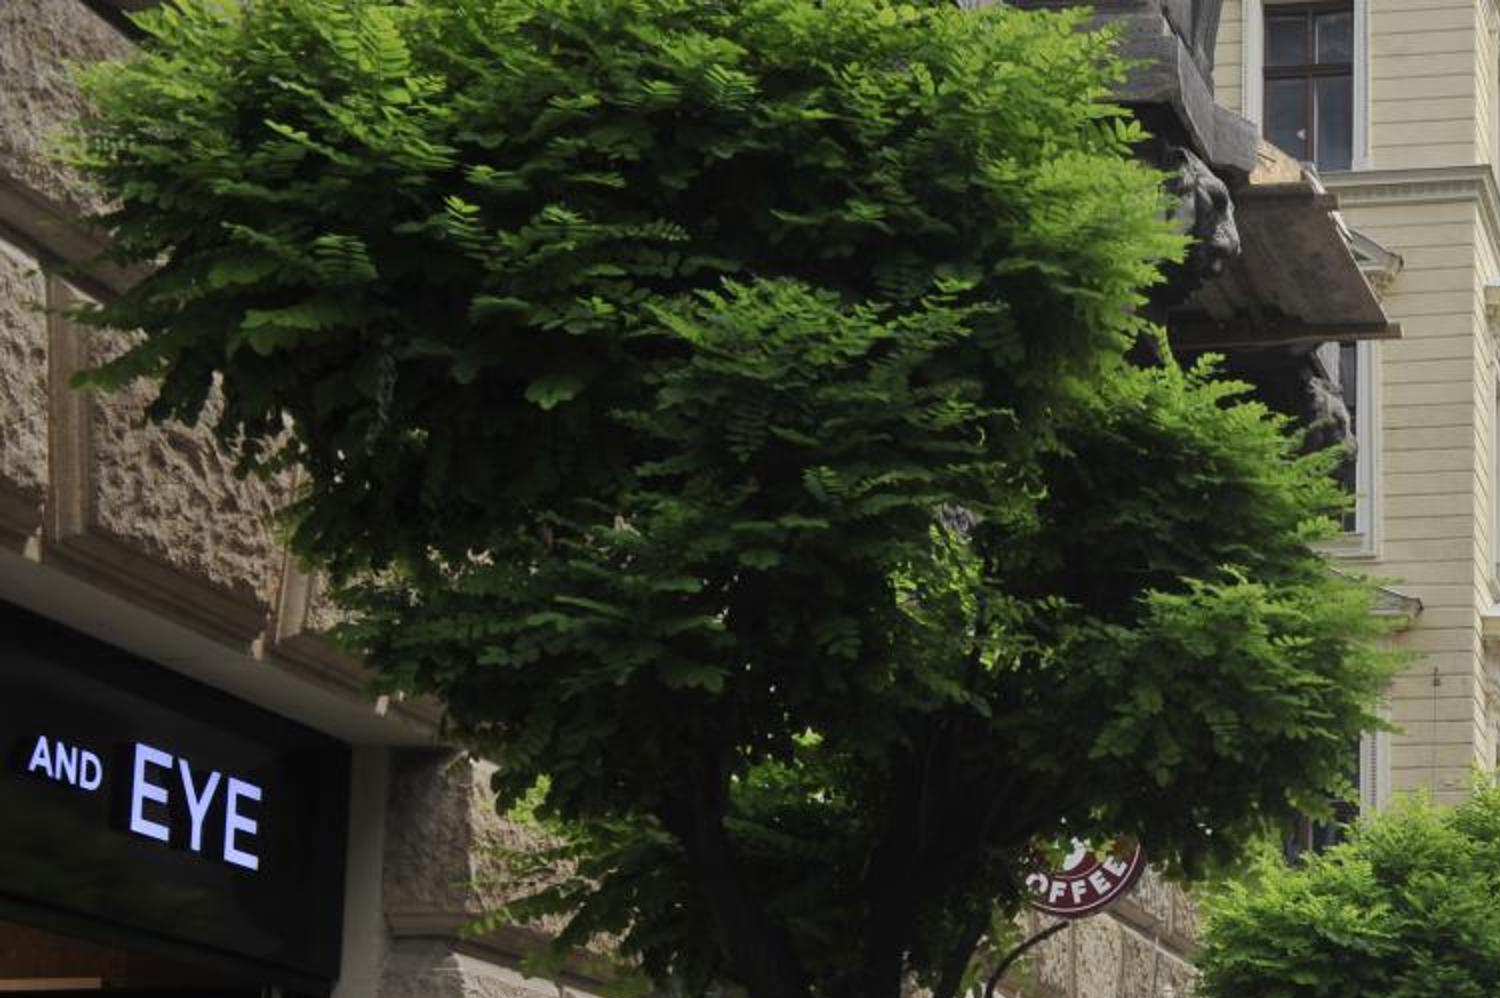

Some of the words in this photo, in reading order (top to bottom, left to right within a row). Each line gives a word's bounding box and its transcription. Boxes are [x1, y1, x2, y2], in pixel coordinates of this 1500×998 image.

[28, 735, 103, 791] AND
[129, 742, 262, 872] EYE
[1023, 856, 1127, 904] OFFEE
